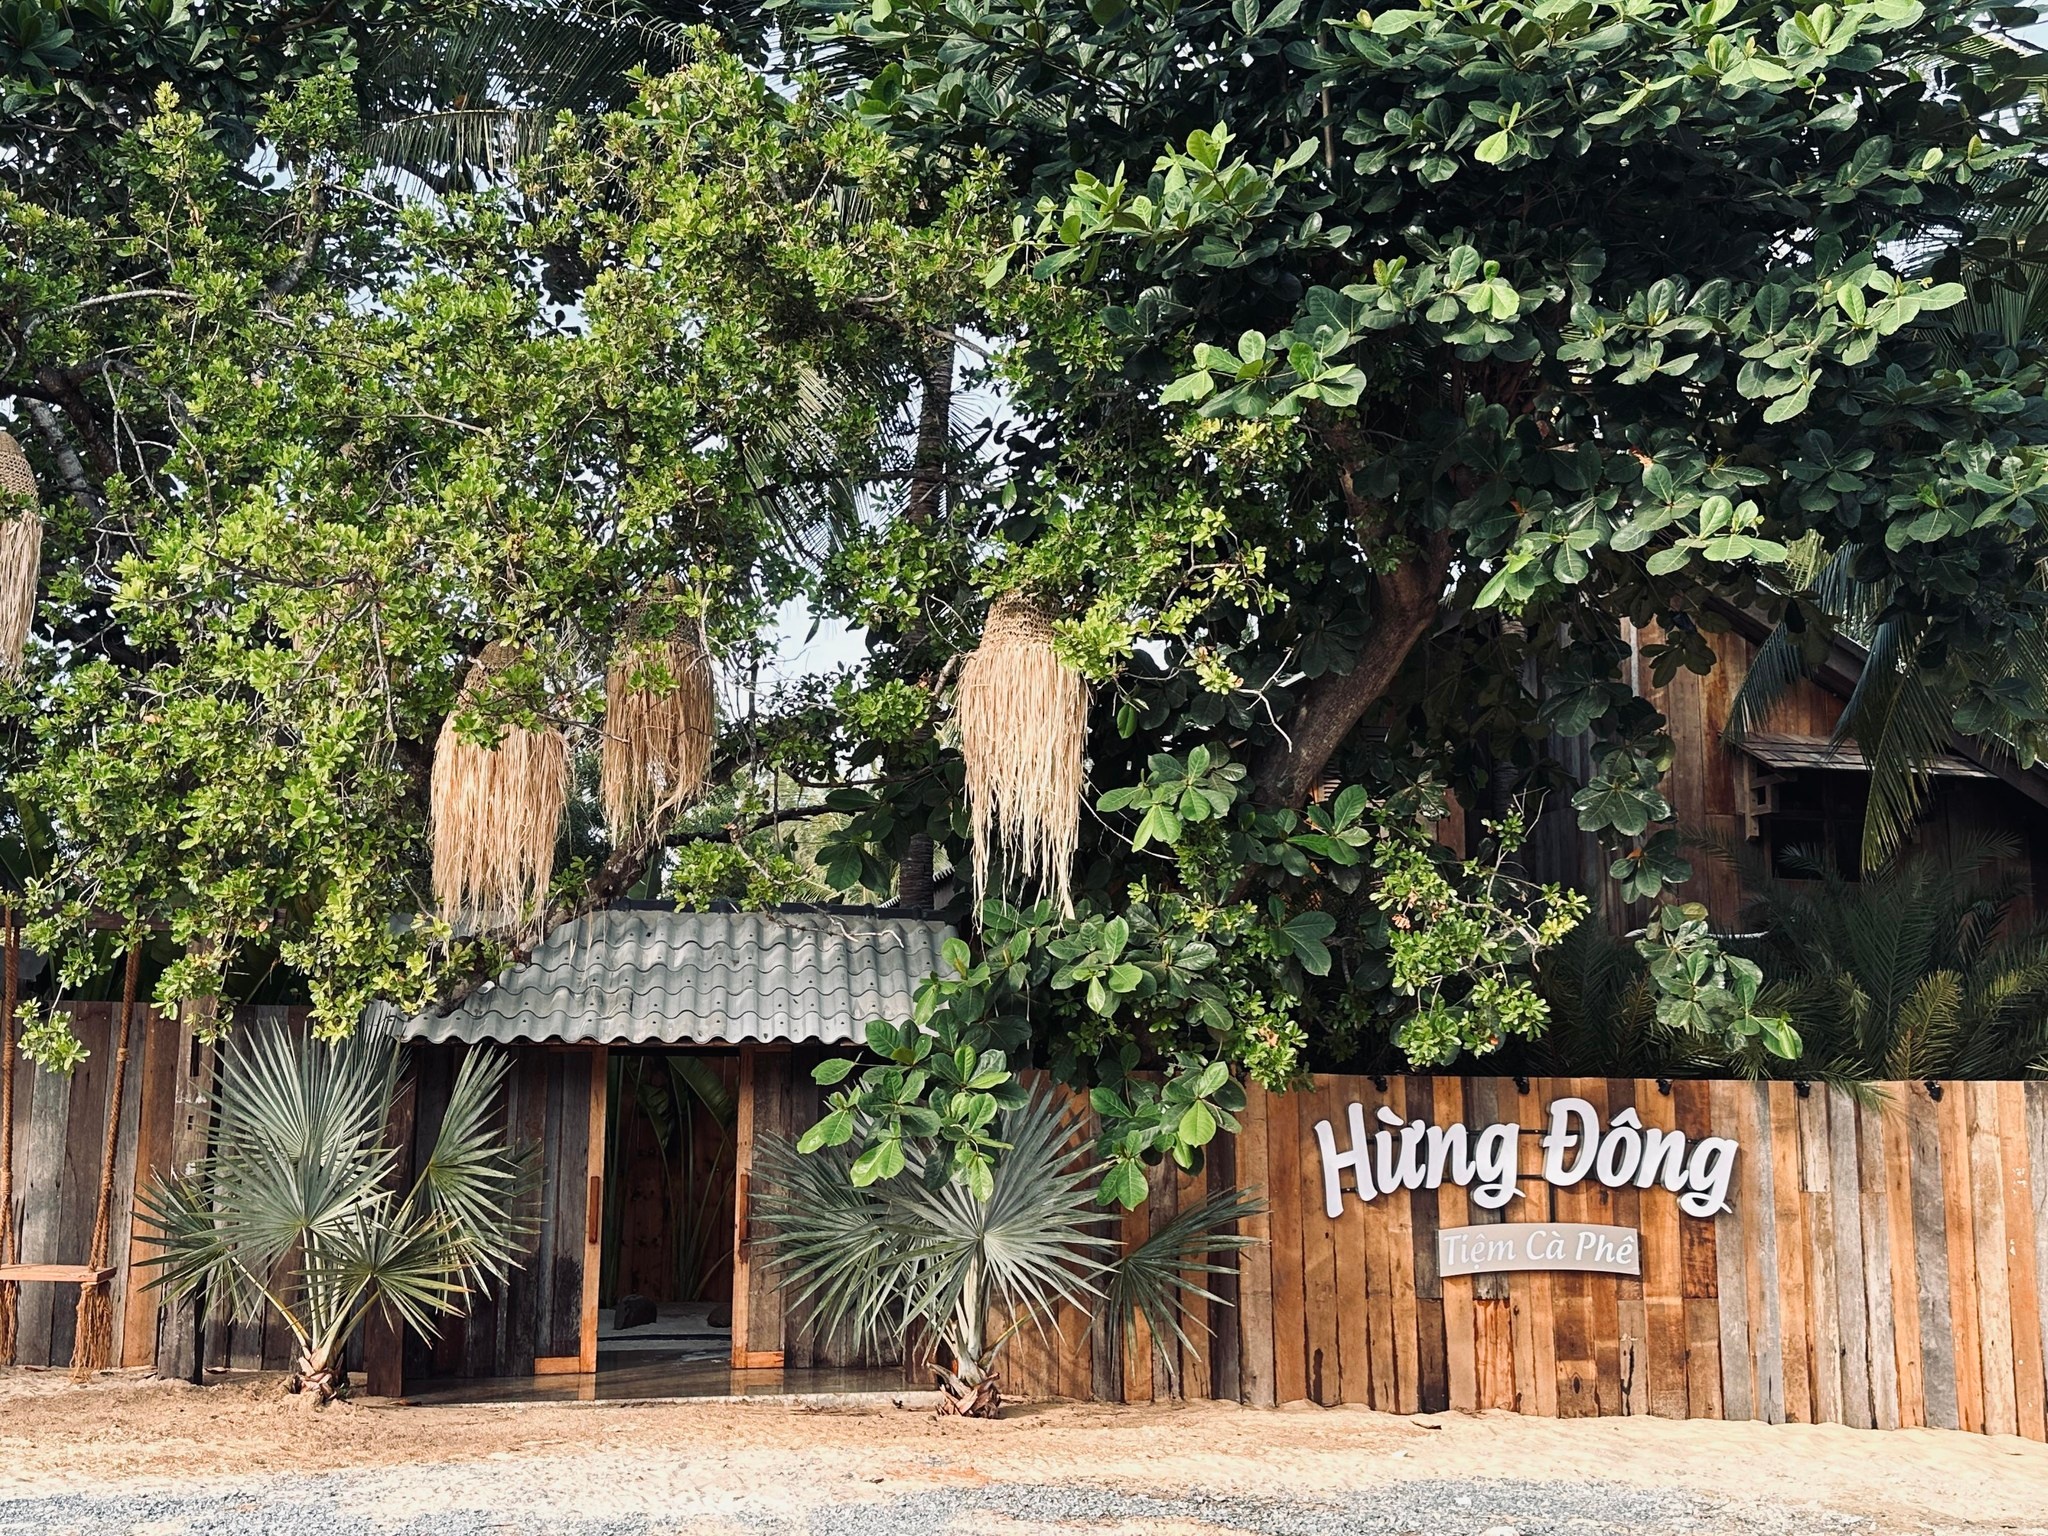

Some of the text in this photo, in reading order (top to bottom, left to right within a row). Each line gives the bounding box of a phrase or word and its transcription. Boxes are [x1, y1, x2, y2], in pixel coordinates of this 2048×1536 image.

[1314, 1098, 1739, 1218] Hừng Đông
[1443, 1230, 1635, 1270] Tiệm Cà Phê
